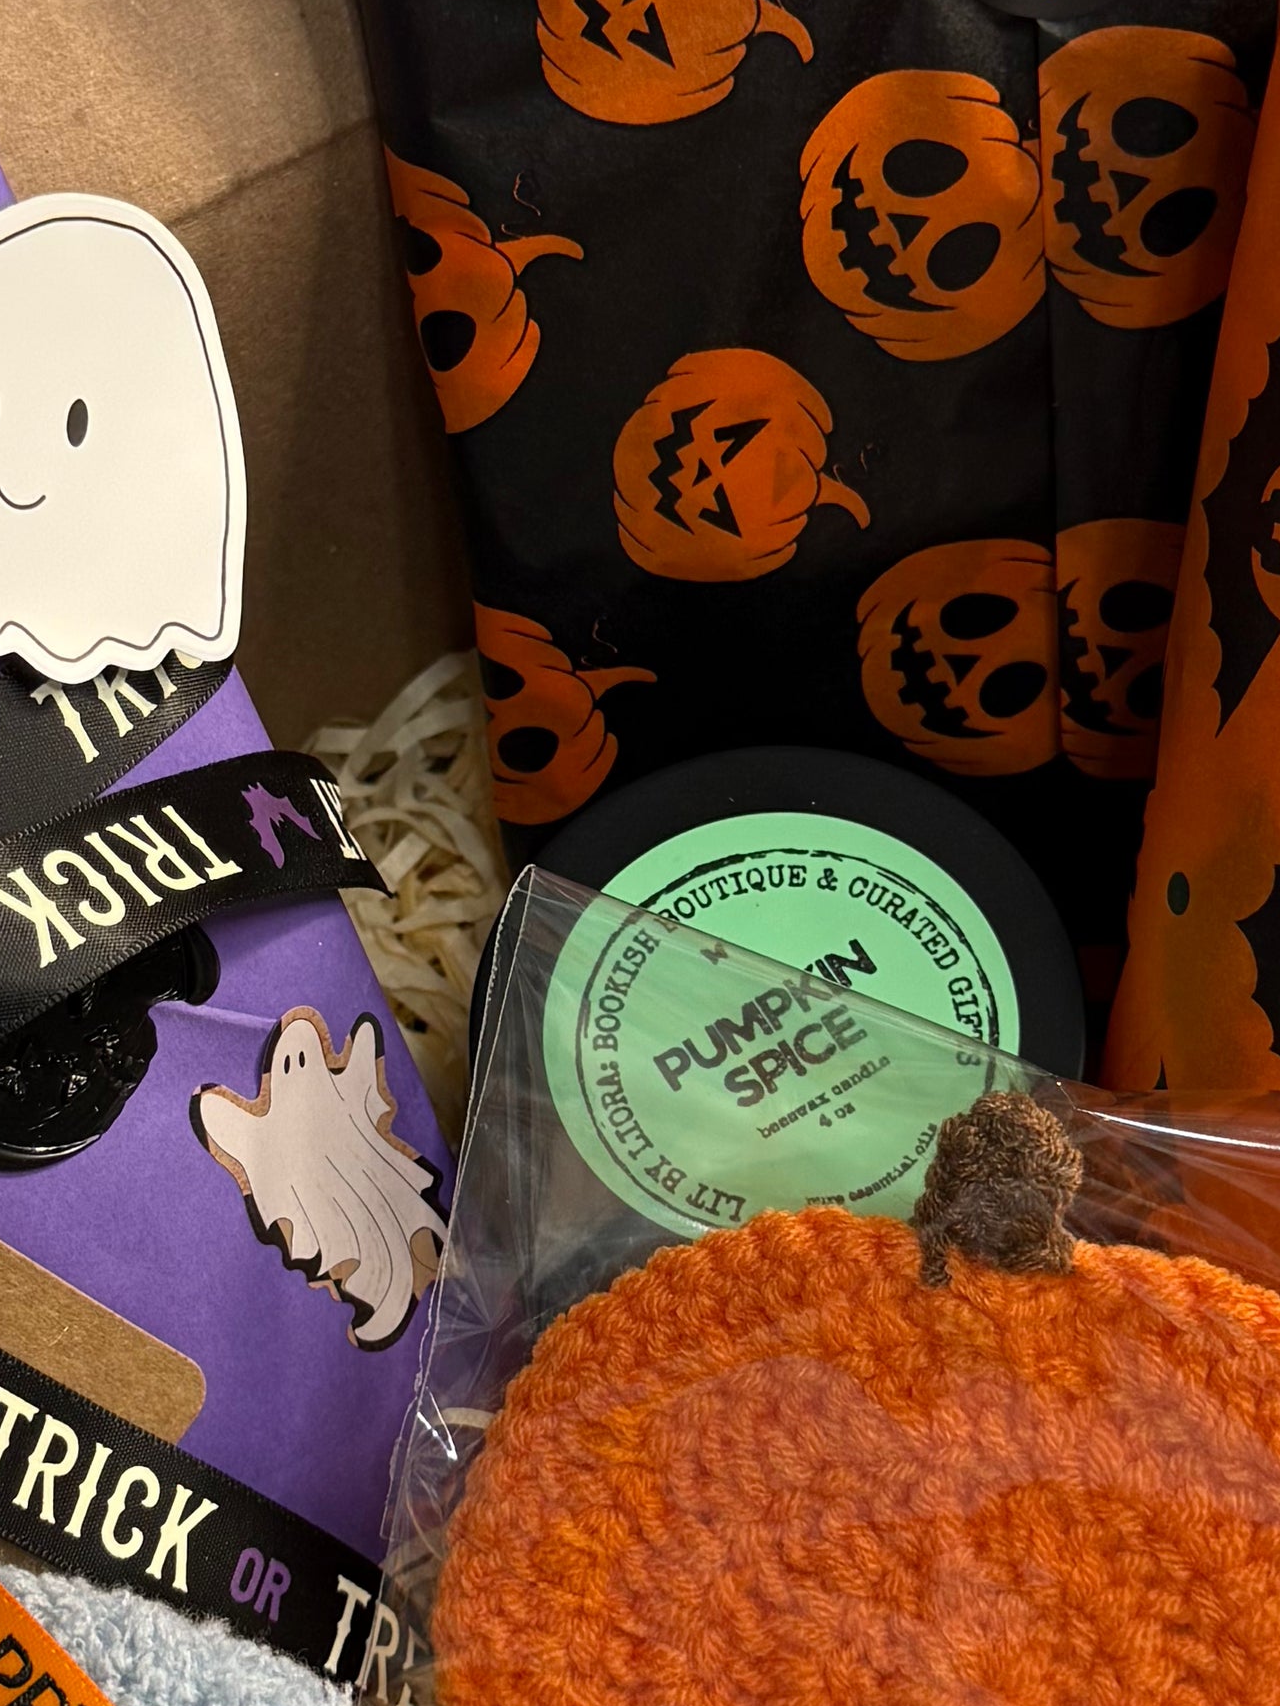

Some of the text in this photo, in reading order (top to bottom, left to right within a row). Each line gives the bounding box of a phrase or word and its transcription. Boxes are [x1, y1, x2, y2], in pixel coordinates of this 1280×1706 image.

[656, 864, 808, 935] BOUTIQUE
[816, 866, 839, 892] &
[848, 875, 963, 973] CURATED
[592, 927, 662, 1052] BOOKISH
[652, 938, 878, 1093] PUMPKIN
[723, 1003, 869, 1108] SPICE
[593, 1060, 655, 1160] LIORA:
[644, 1154, 689, 1193] BY
[686, 1181, 748, 1223] LIT
[230, 1546, 292, 1622] OR
